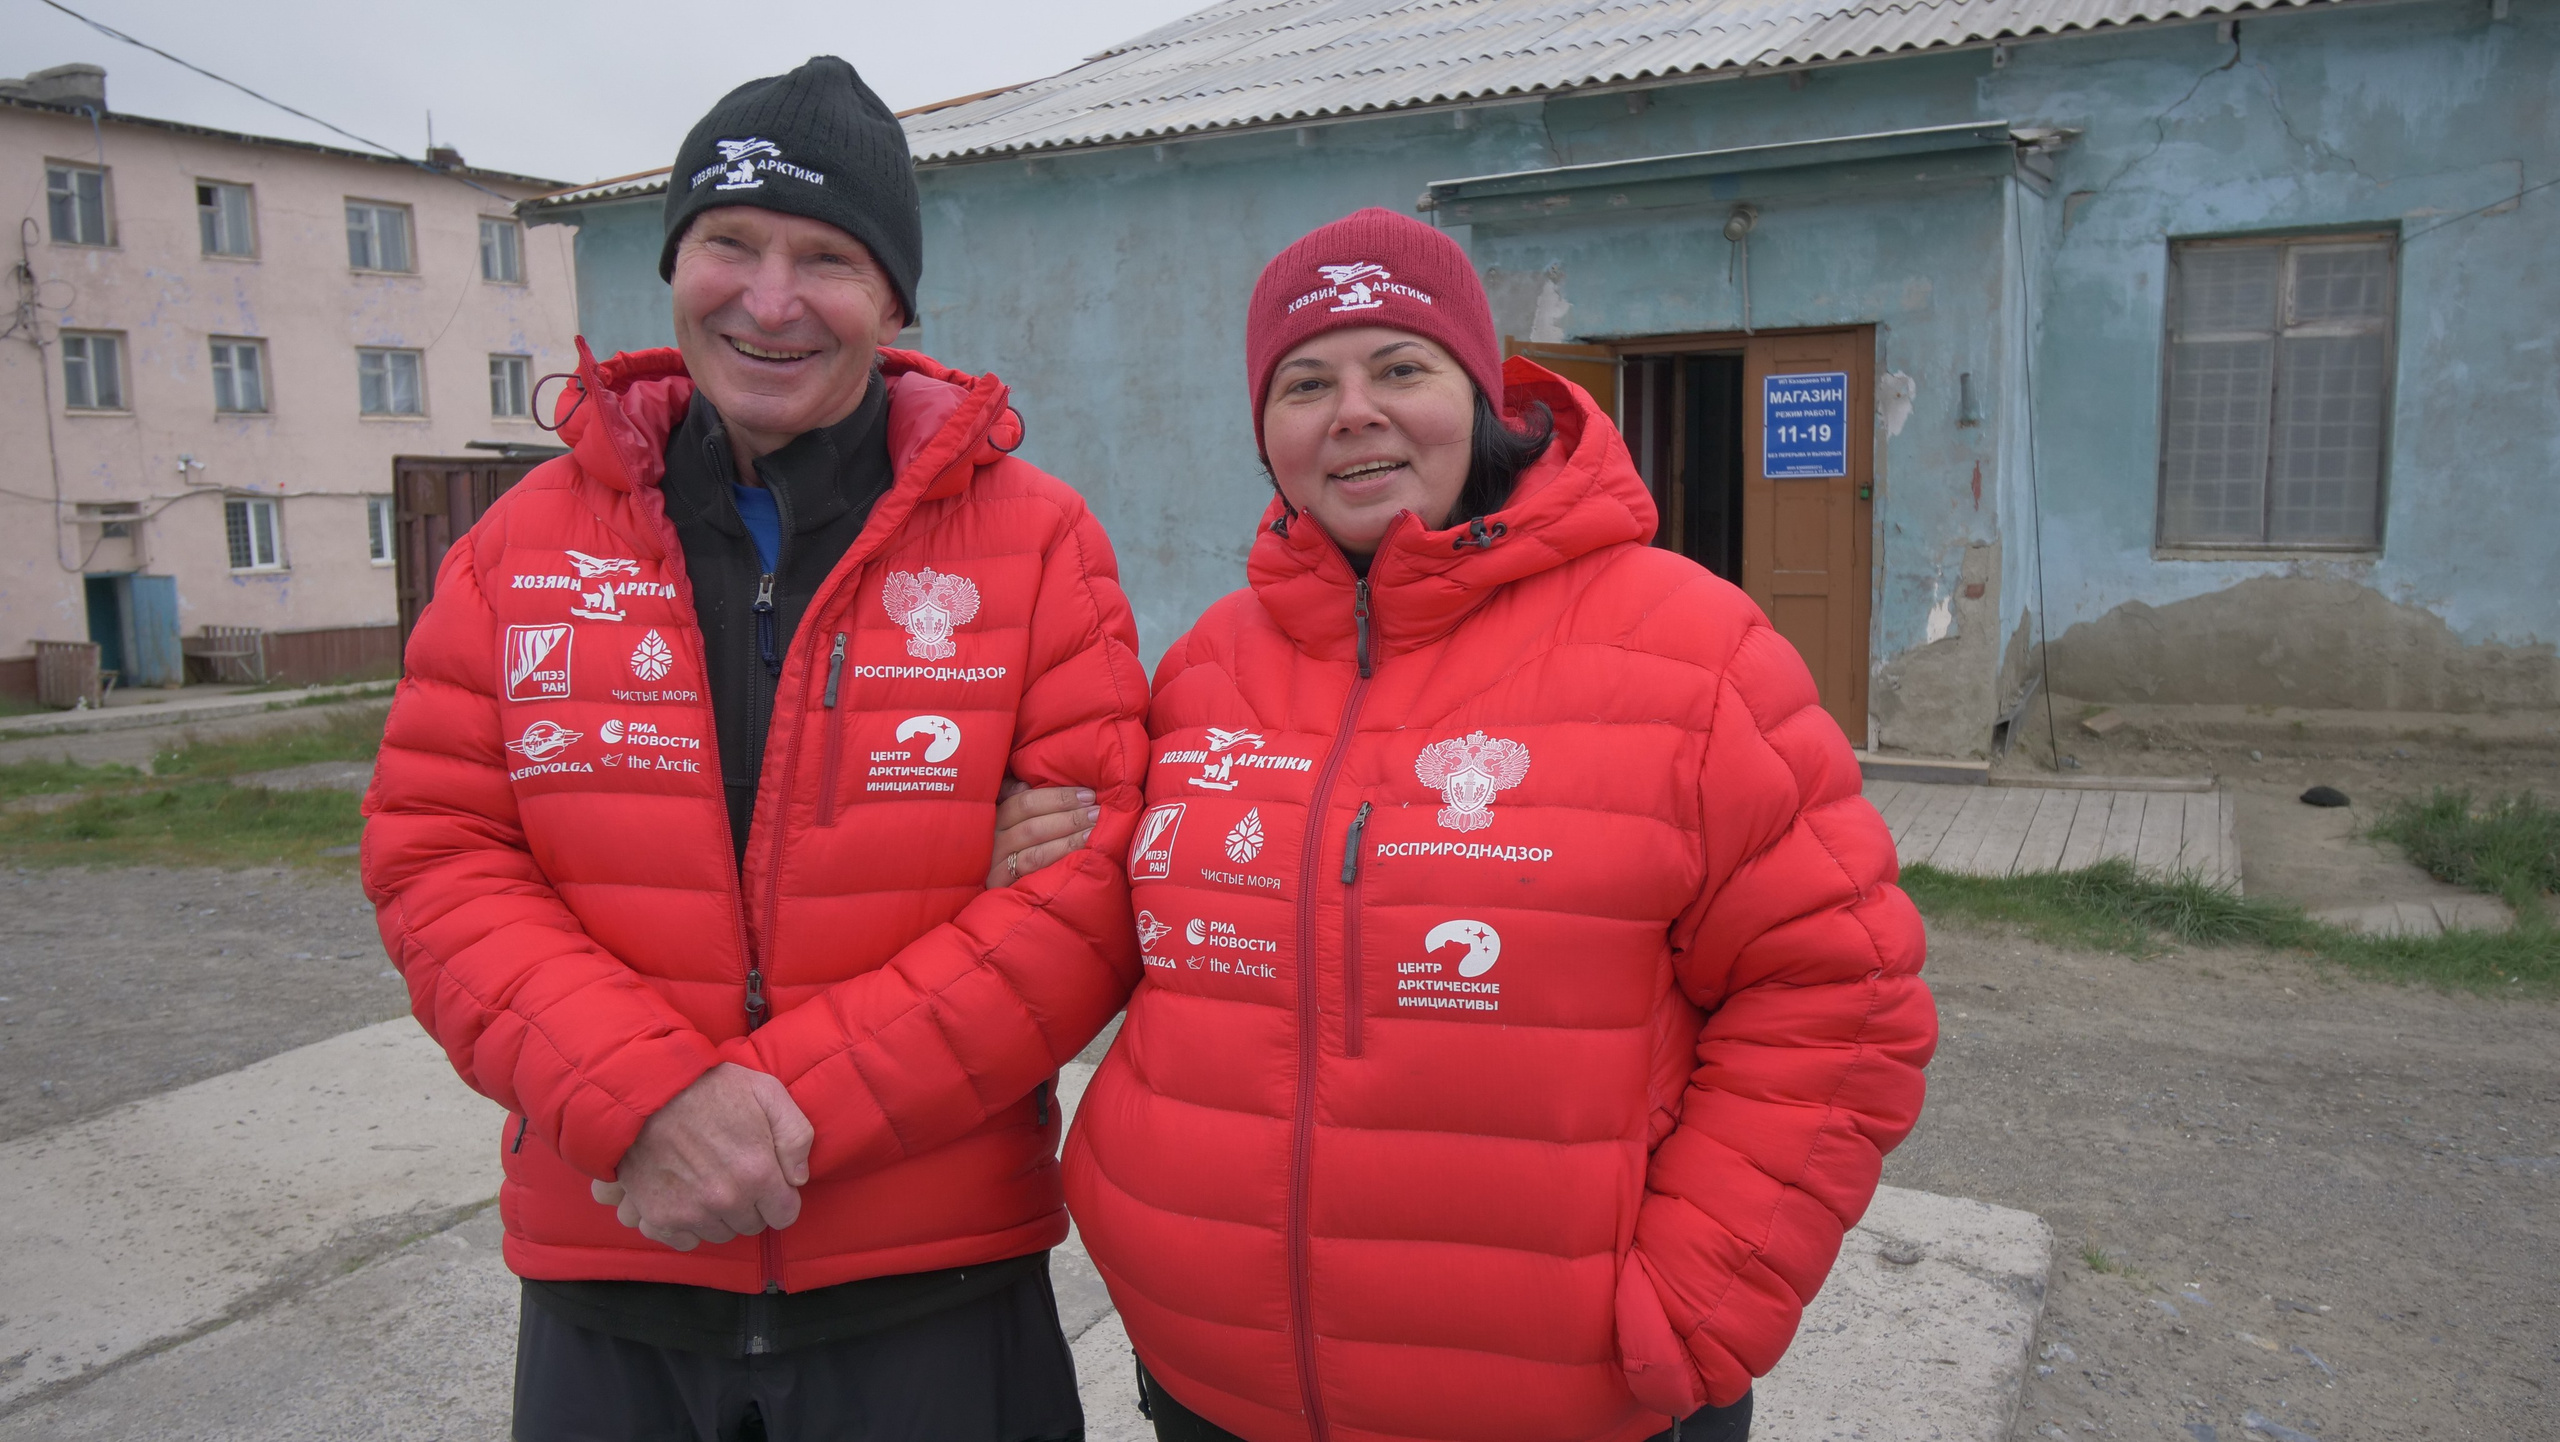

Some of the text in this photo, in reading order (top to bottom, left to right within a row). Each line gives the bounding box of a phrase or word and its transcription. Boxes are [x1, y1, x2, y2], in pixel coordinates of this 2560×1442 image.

[692, 159, 824, 189] ХОЗЯИН АРКТИКИ
[1288, 282, 1432, 315] ХОЗЯИН АРКТИКИ
[1770, 389, 1842, 404] МАГАЗИН
[1776, 409, 1836, 419] РЕЖИМ РАБОТЫ
[1778, 424, 1831, 443] 11-19
[512, 573, 582, 591] ХОЗЯИН
[532, 669, 565, 681] ИПЭЭ
[855, 666, 1006, 682] РОСПРИРОДНАДЗОР
[542, 682, 565, 692] РАН
[612, 690, 697, 701] ЧИСТЫЕ МОРЯ
[629, 723, 657, 733] РИА
[628, 735, 699, 749] НОВОСТИ
[871, 752, 910, 762] ЦЕНТР
[1159, 751, 1312, 771] ХОЗЯИН АРКТИКИ
[629, 755, 700, 773] the Arctic
[510, 762, 594, 782] AEROVOLGA
[869, 767, 958, 777] АРКТИЧЕСКИЕ
[867, 782, 954, 792] ИНИЦИАТИВЫ
[1144, 849, 1167, 860] ИПЭЭ
[1377, 842, 1552, 862] РОСПРИРОДНАДЗОР
[1150, 862, 1166, 872] РАН
[1201, 869, 1280, 889] ЧИСТЫЕ МОРЯ
[1210, 922, 1235, 934] РИА
[1210, 935, 1276, 952] НОВОСТИ
[1210, 958, 1276, 978] the Arctic
[1398, 963, 1442, 974] ЦЕНТР
[1398, 980, 1499, 993] АРКТИЧЕСКИЕ
[1399, 997, 1498, 1010] ИНИЦИАТИВЫ
